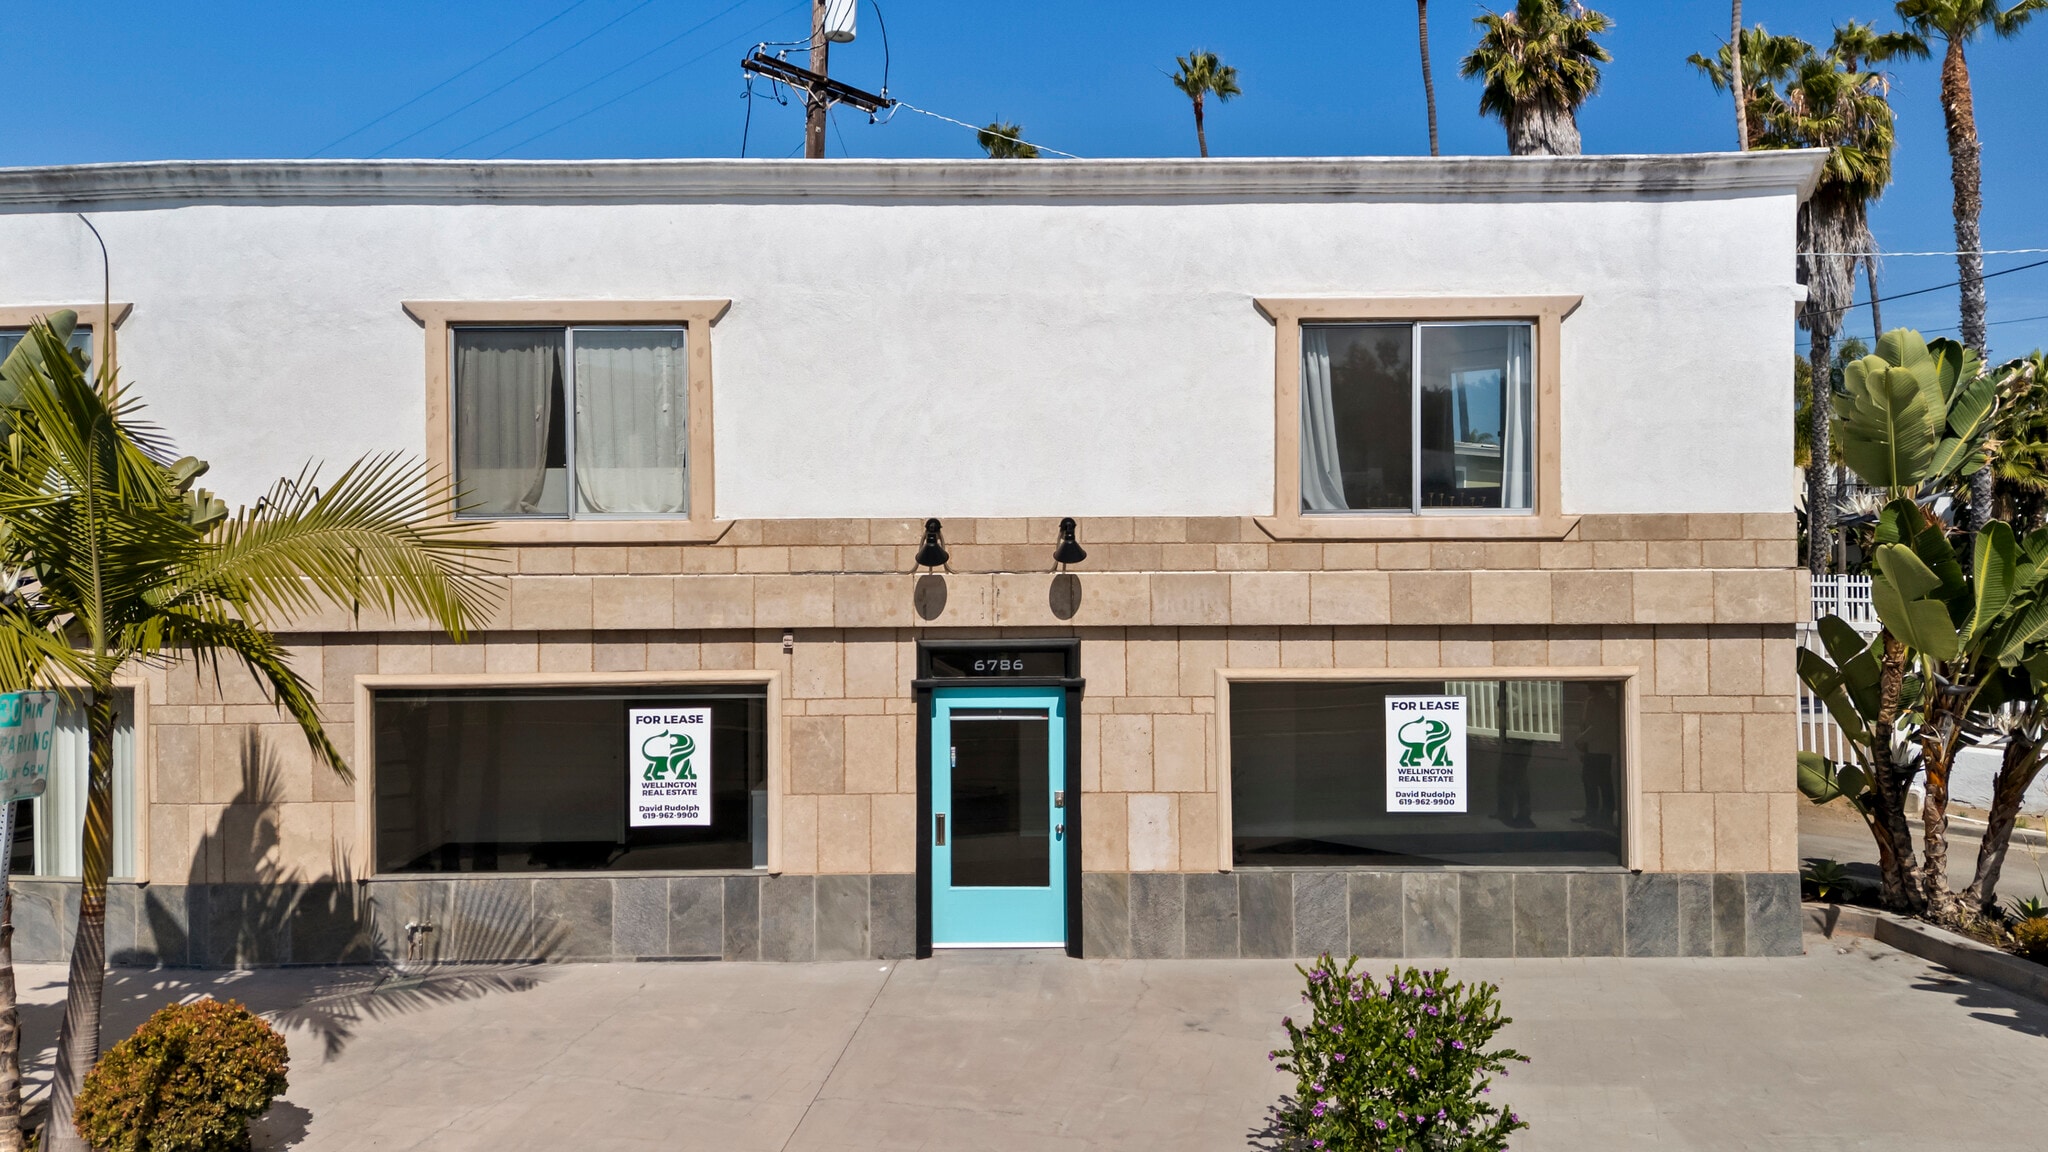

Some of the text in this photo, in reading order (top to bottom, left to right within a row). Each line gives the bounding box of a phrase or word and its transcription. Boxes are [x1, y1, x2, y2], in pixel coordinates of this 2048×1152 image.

[974, 659, 1024, 671] 6786
[1391, 701, 1460, 710] FOR LEASE
[0, 699, 44, 722] 30 MIN
[636, 715, 704, 725] FOR LEASE
[1421, 791, 1456, 799] Rudolph
[665, 804, 700, 813] Rudolph
